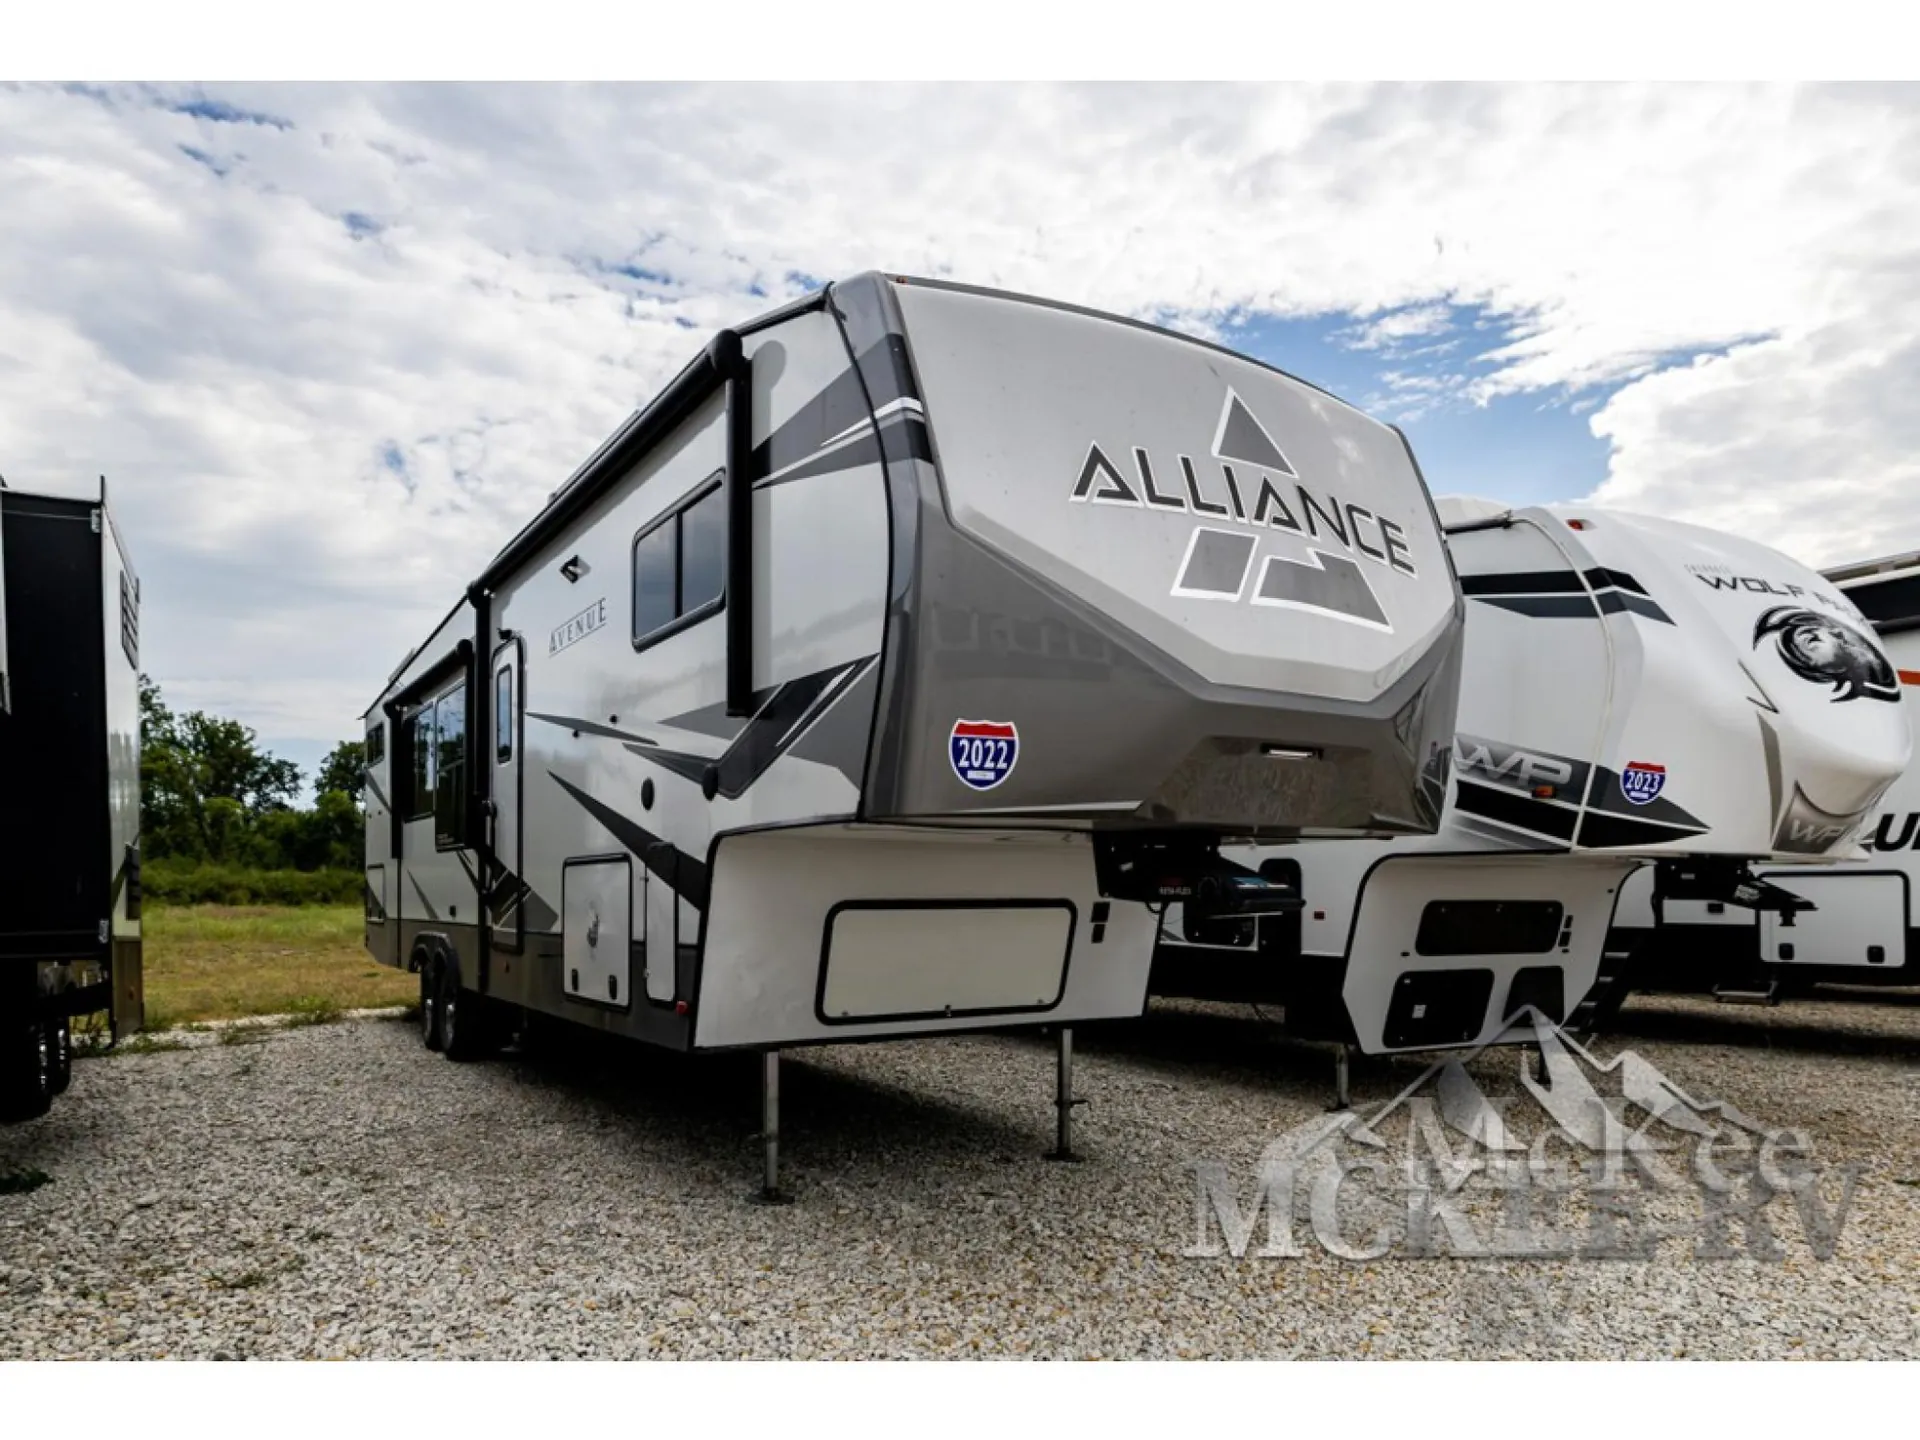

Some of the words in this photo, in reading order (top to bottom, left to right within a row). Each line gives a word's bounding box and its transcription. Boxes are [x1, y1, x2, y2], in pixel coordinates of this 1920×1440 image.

[1069, 440, 1417, 579] ALLIANCE
[1696, 573, 1805, 598] WOLF
[548, 597, 606, 654] AVENUE
[958, 738, 1008, 769] 2022
[1453, 737, 1572, 785] WP
[1625, 770, 1660, 793] 2023
